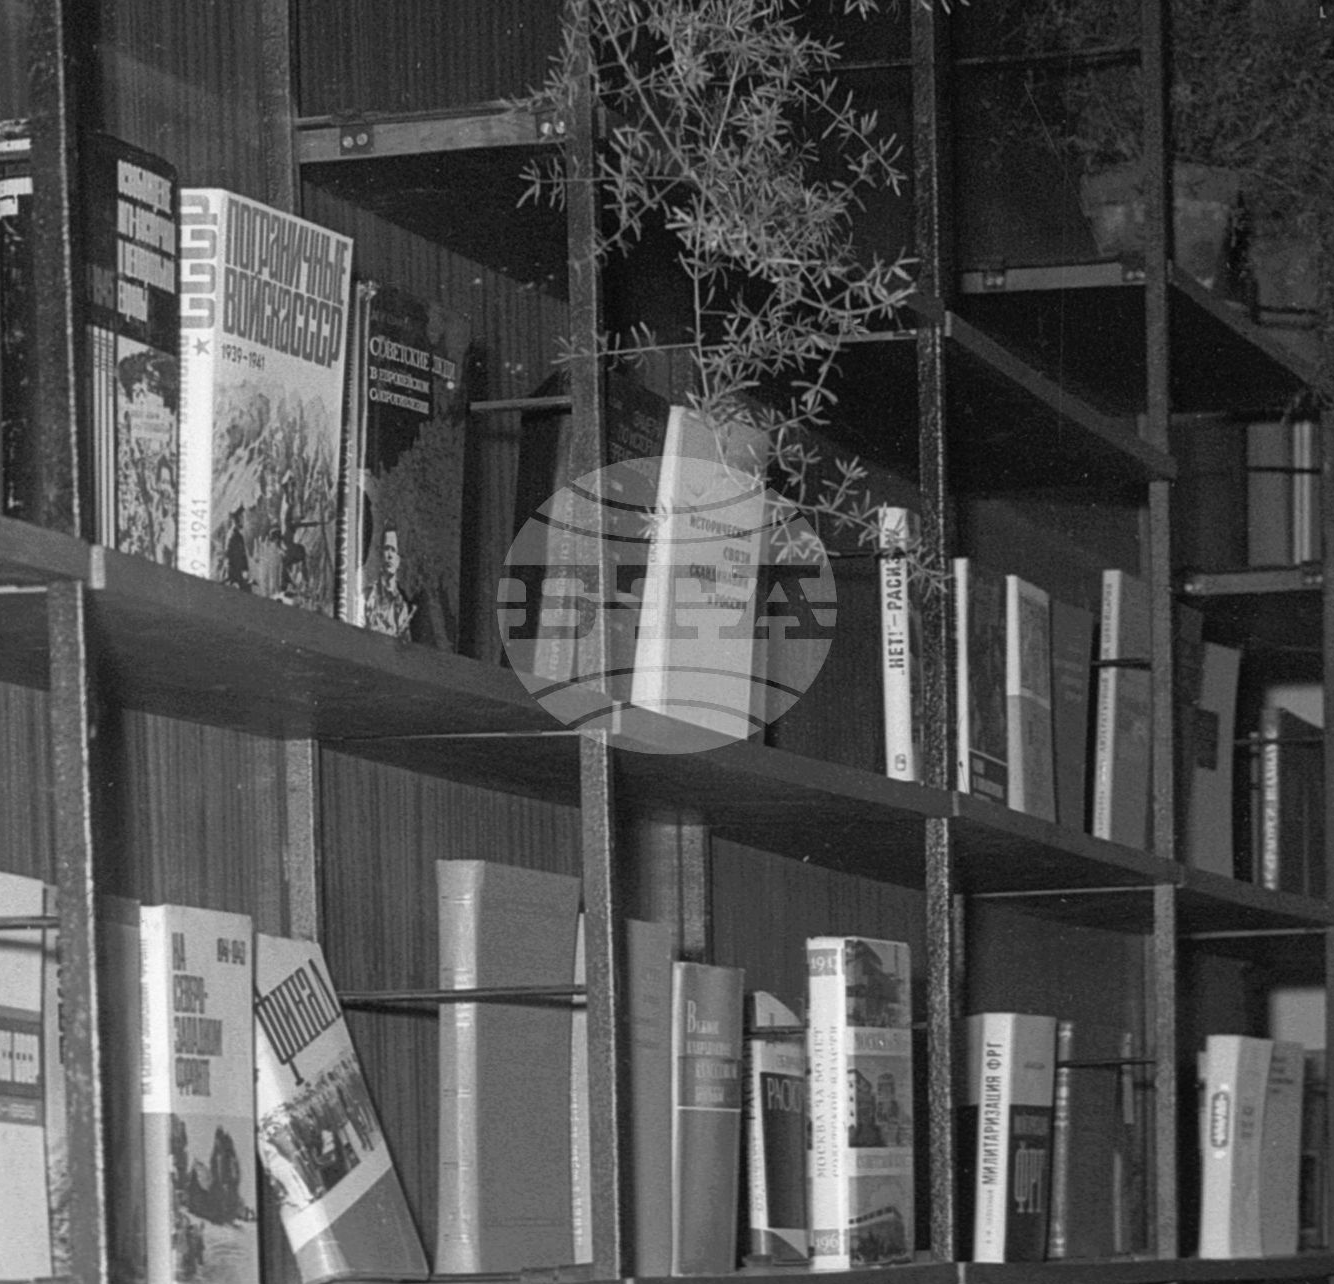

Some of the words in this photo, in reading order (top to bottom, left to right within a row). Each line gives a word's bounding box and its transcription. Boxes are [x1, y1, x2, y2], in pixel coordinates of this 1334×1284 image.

[224, 197, 350, 307] ПОГРАНИЧНЫЕ
[223, 267, 292, 355] ВОЙСКА
[290, 292, 343, 369] СССР
[221, 344, 266, 370] 1939-1941
[370, 335, 431, 371] СОВЕТСКИЕ
[369, 366, 378, 379] В
[723, 546, 751, 565] СВЯЗИ
[254, 958, 343, 1087] ФИНАЛ
[813, 1026, 824, 1059] ЛЕТ
[986, 1042, 1004, 1071] ФРГ
[814, 1114, 828, 1178] МОСКВА
[981, 1075, 1004, 1186] МИЛИТАРИЗАЦИЯ
